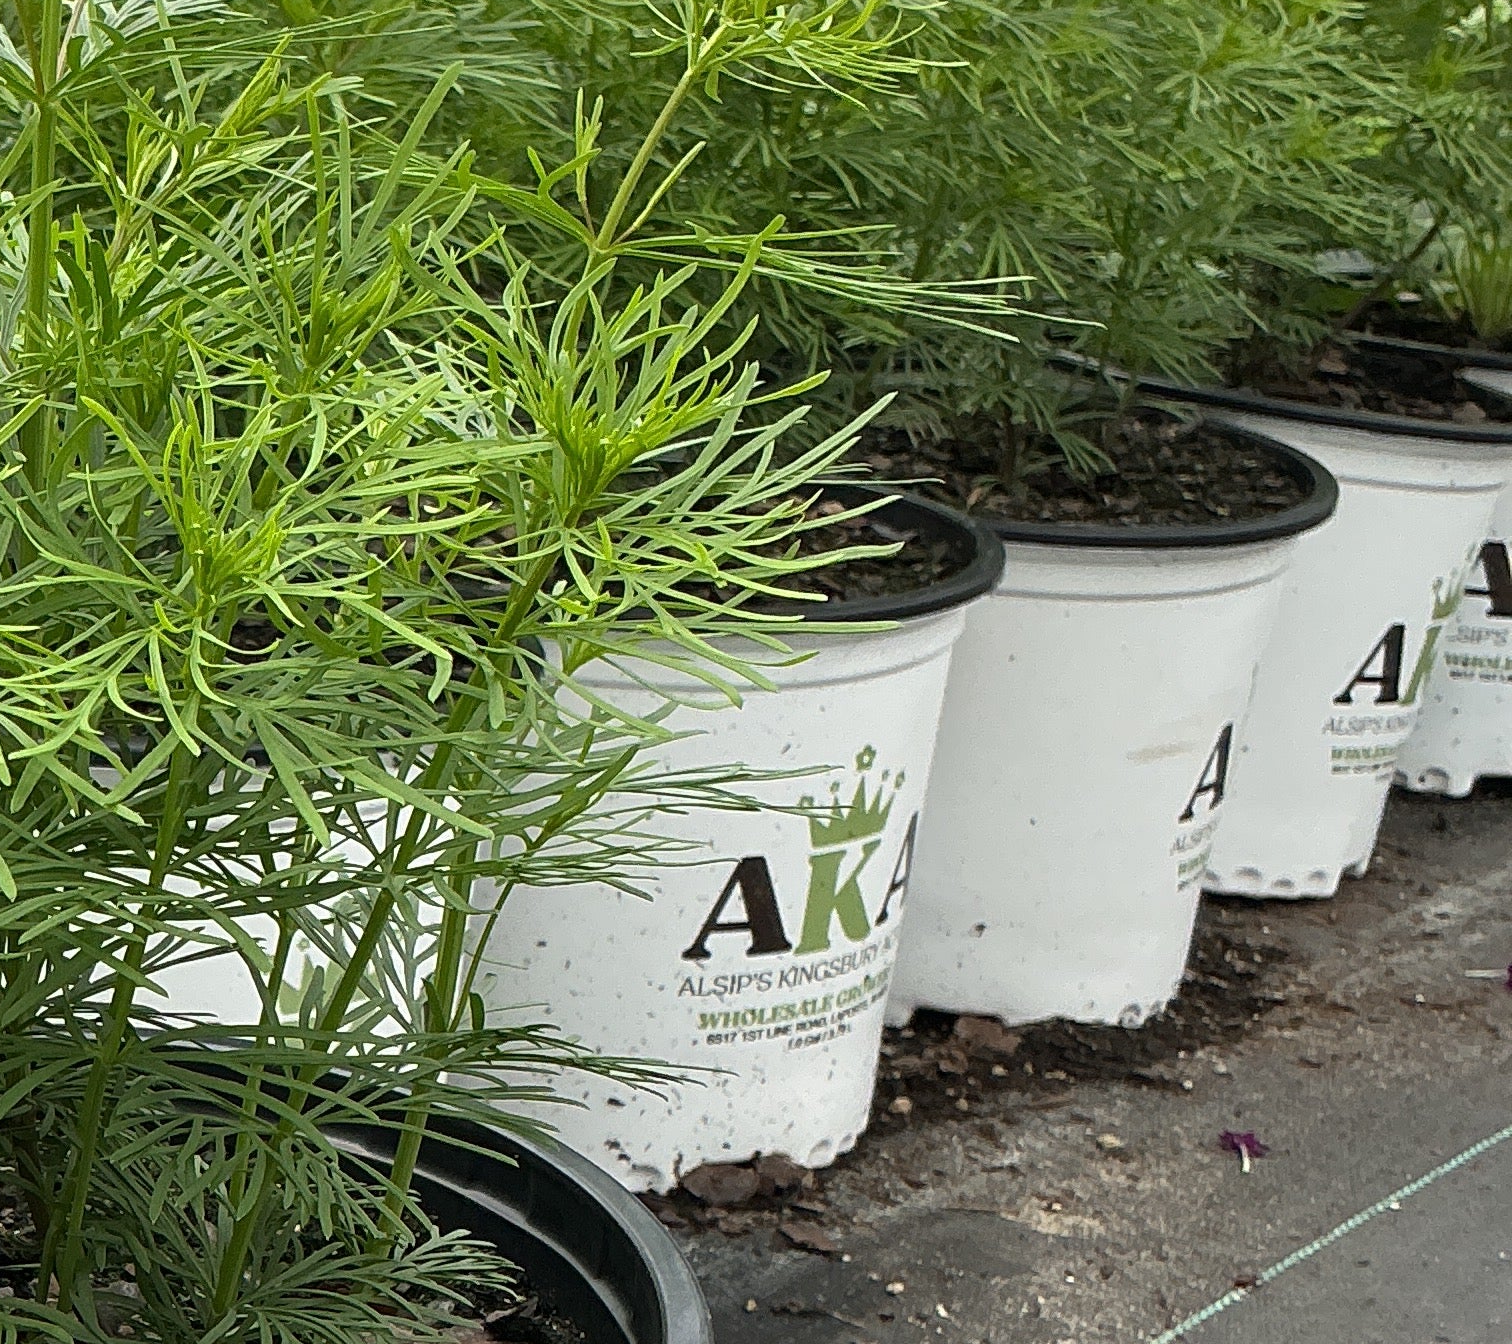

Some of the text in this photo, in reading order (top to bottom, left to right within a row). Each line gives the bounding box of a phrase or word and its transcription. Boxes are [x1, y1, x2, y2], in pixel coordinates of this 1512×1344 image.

[678, 972, 773, 997] ALSIP'S
[777, 942, 879, 989] KINGSBURY
[698, 992, 834, 1030] WHOLESALE
